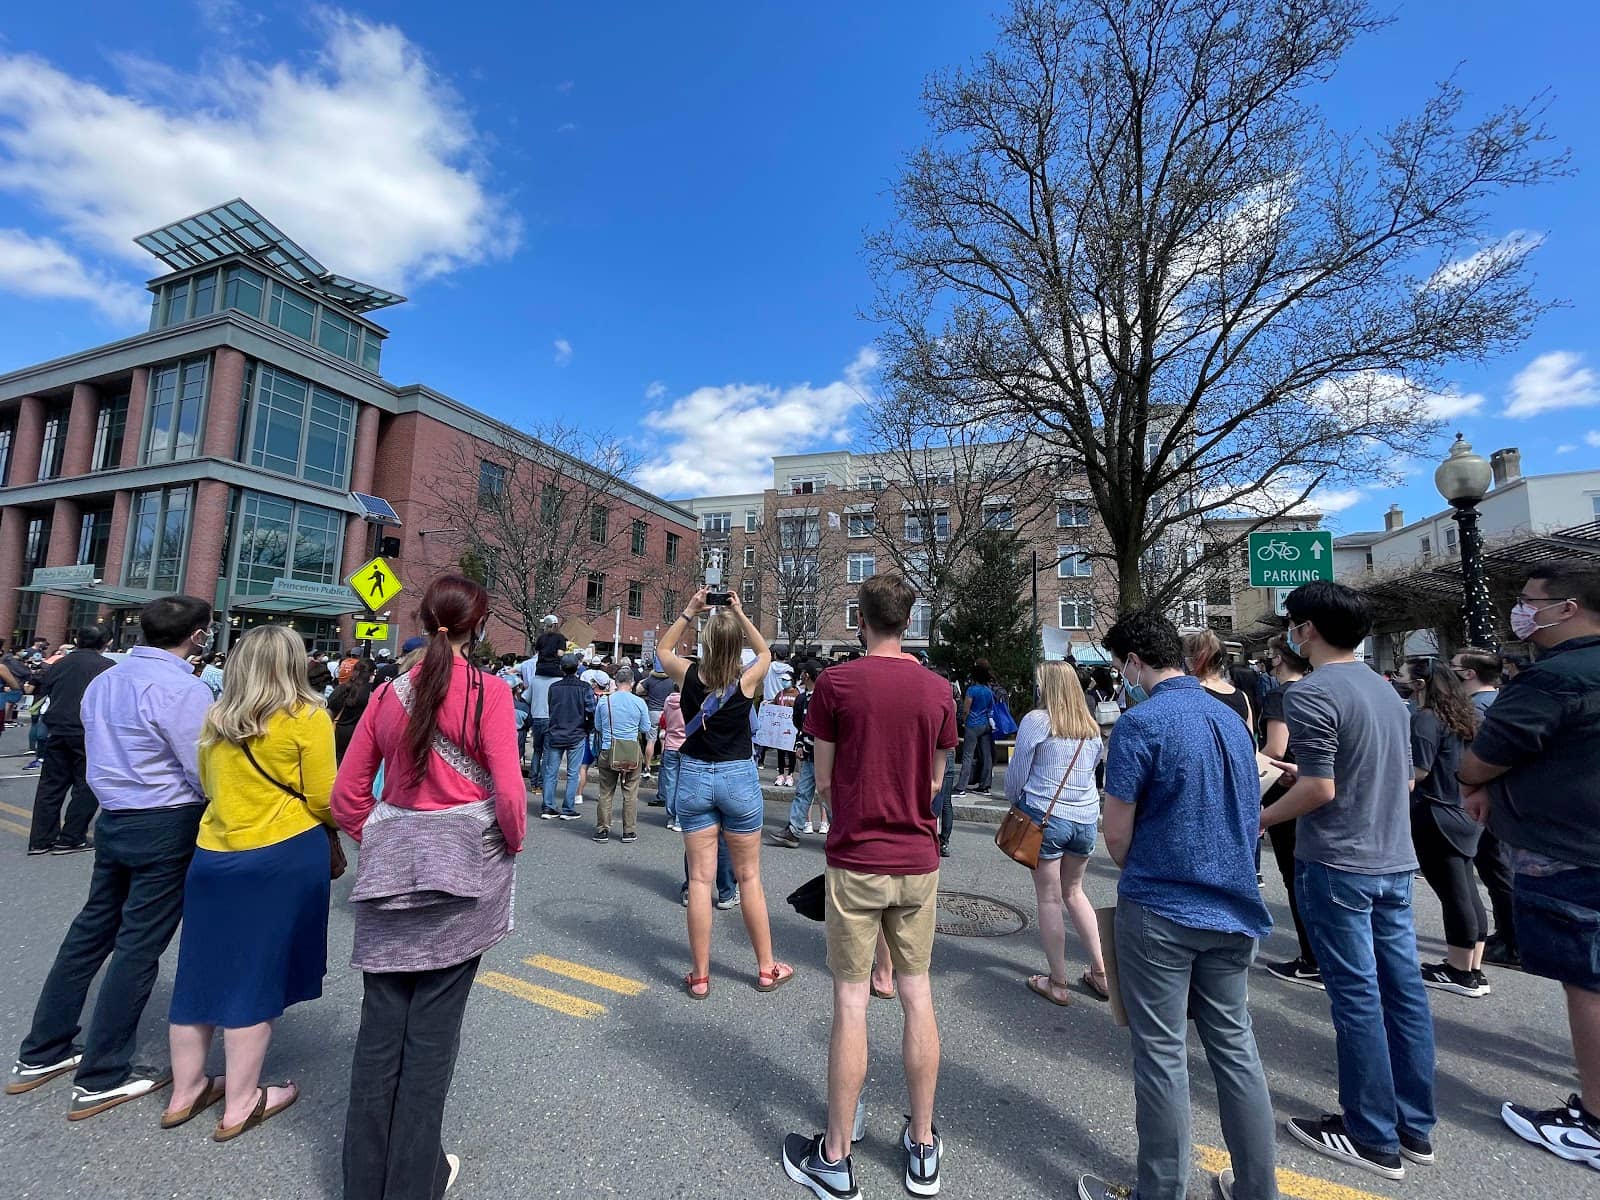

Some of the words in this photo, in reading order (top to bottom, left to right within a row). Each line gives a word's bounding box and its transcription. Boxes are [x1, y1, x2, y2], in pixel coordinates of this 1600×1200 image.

[1263, 569, 1320, 581] PARKING
[278, 581, 319, 592] Princeton
[321, 586, 345, 596] Public
